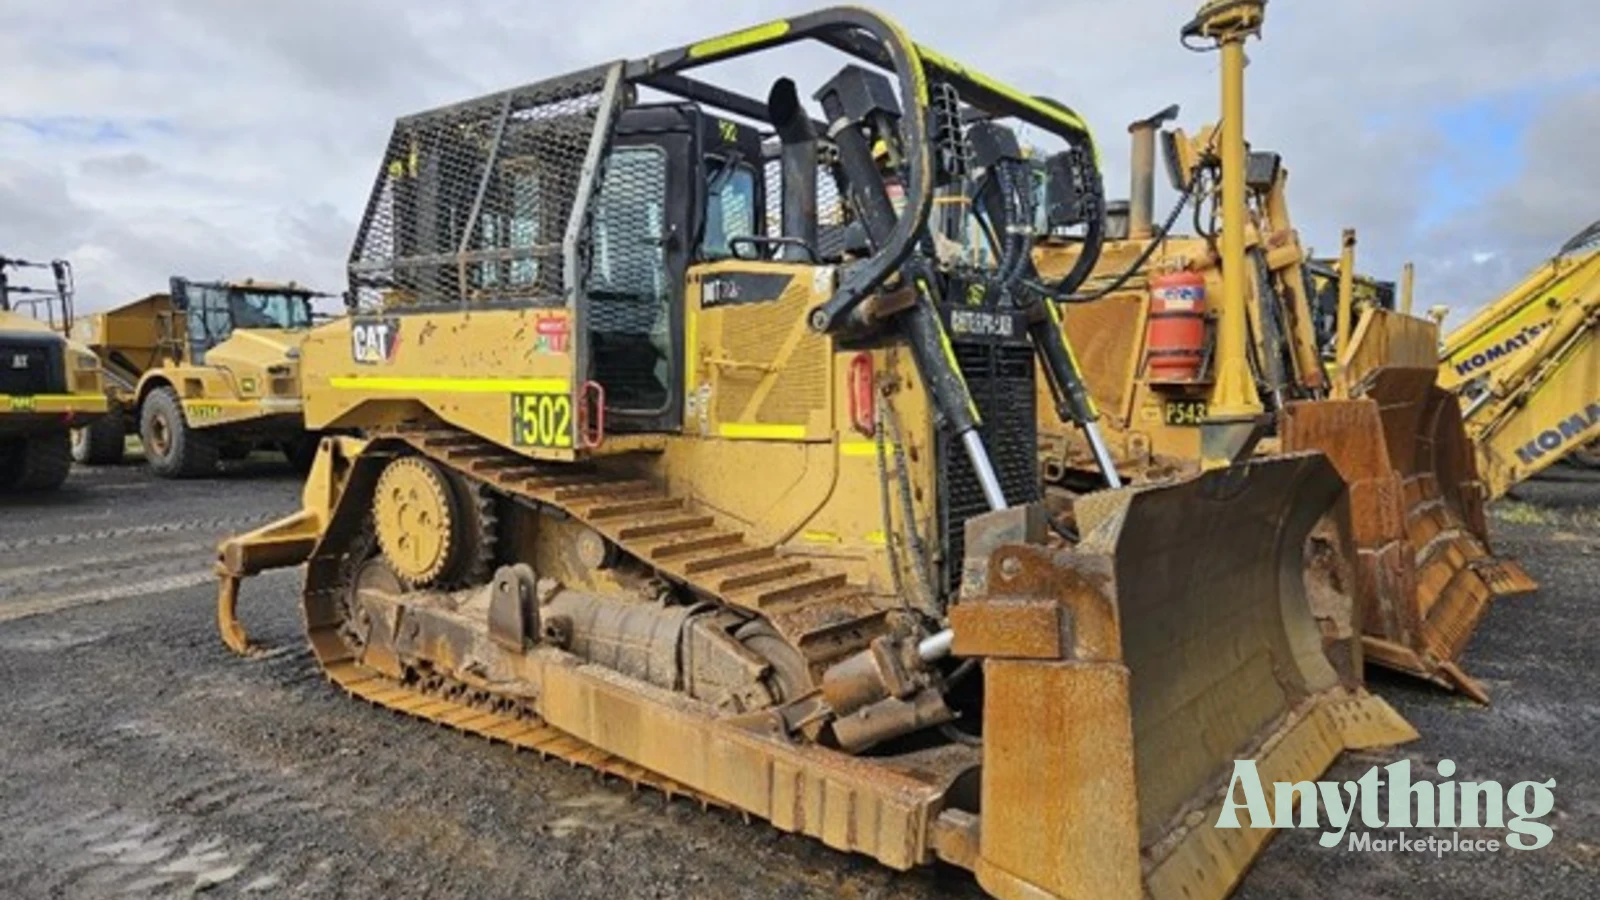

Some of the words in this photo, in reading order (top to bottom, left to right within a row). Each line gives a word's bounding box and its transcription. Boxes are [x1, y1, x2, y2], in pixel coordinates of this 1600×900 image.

[353, 325, 388, 361] CAT
[523, 395, 571, 445] 502
[1166, 402, 1206, 424] P543
